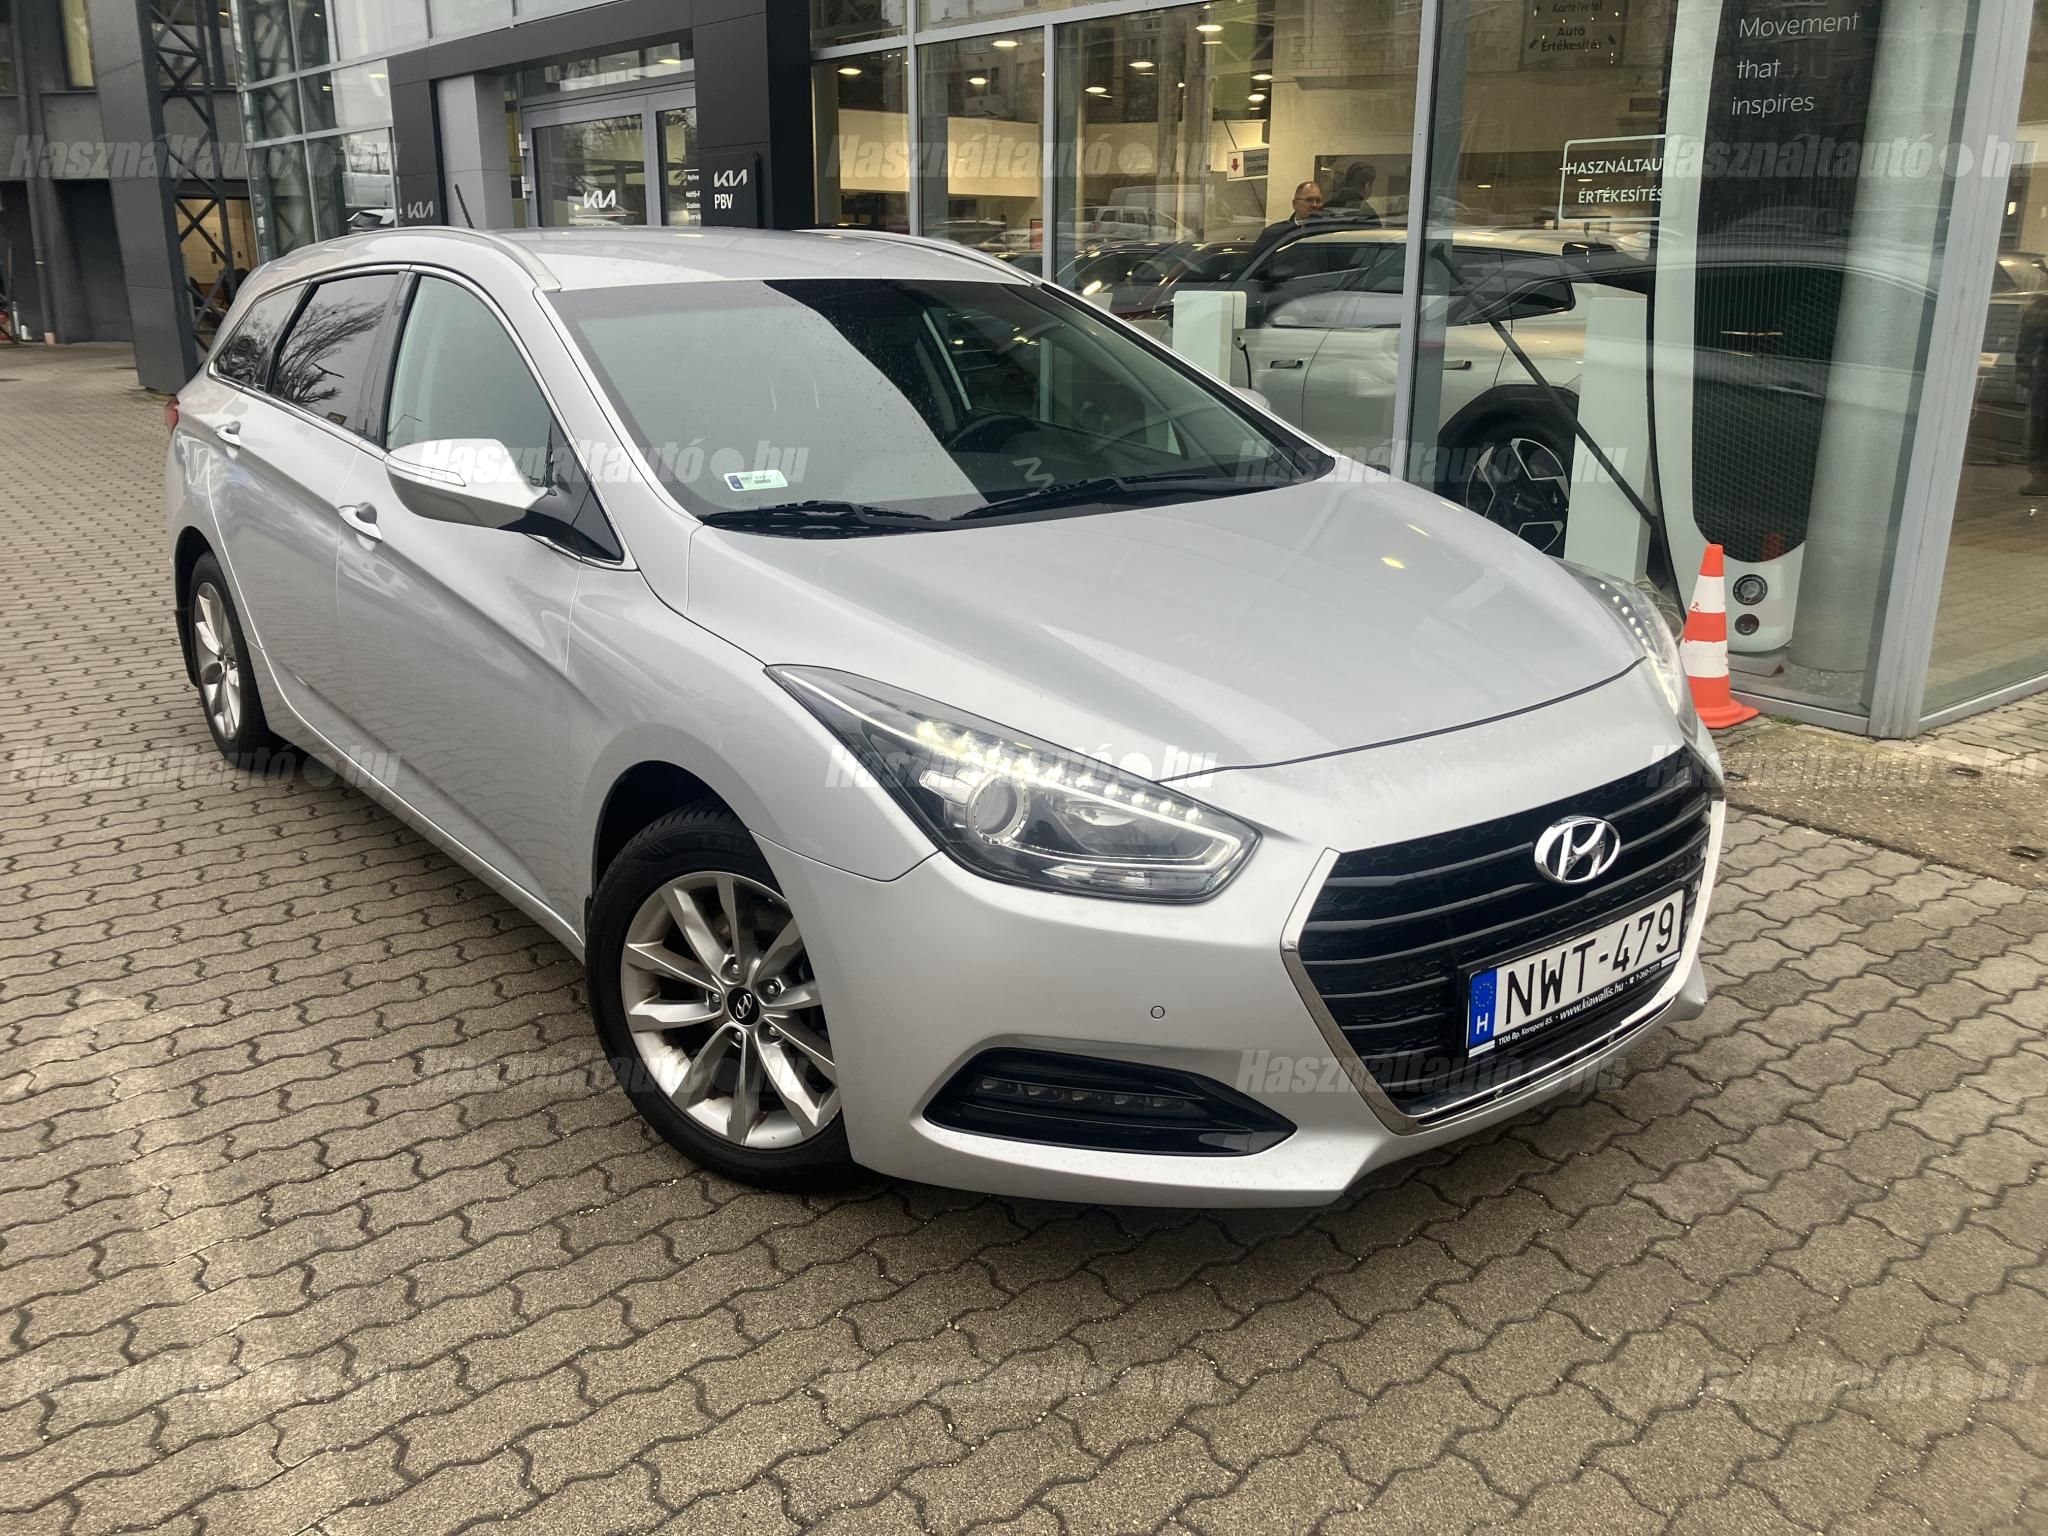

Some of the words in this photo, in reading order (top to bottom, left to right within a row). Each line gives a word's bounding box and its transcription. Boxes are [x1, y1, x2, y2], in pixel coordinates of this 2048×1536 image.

[1738, 11, 1860, 39] Movement
[1736, 58, 1782, 80] that
[1731, 93, 1815, 119] inspires
[1567, 156, 1665, 175] HASZNÁLTAU
[713, 168, 748, 188] KIA
[407, 200, 434, 219] KIA
[584, 189, 617, 209] KIA
[714, 193, 733, 210] PBV
[1505, 901, 1675, 1026] NWT-479
[1559, 981, 1625, 1021] www.kiawallis.hu
[1476, 1012, 1490, 1035] H
